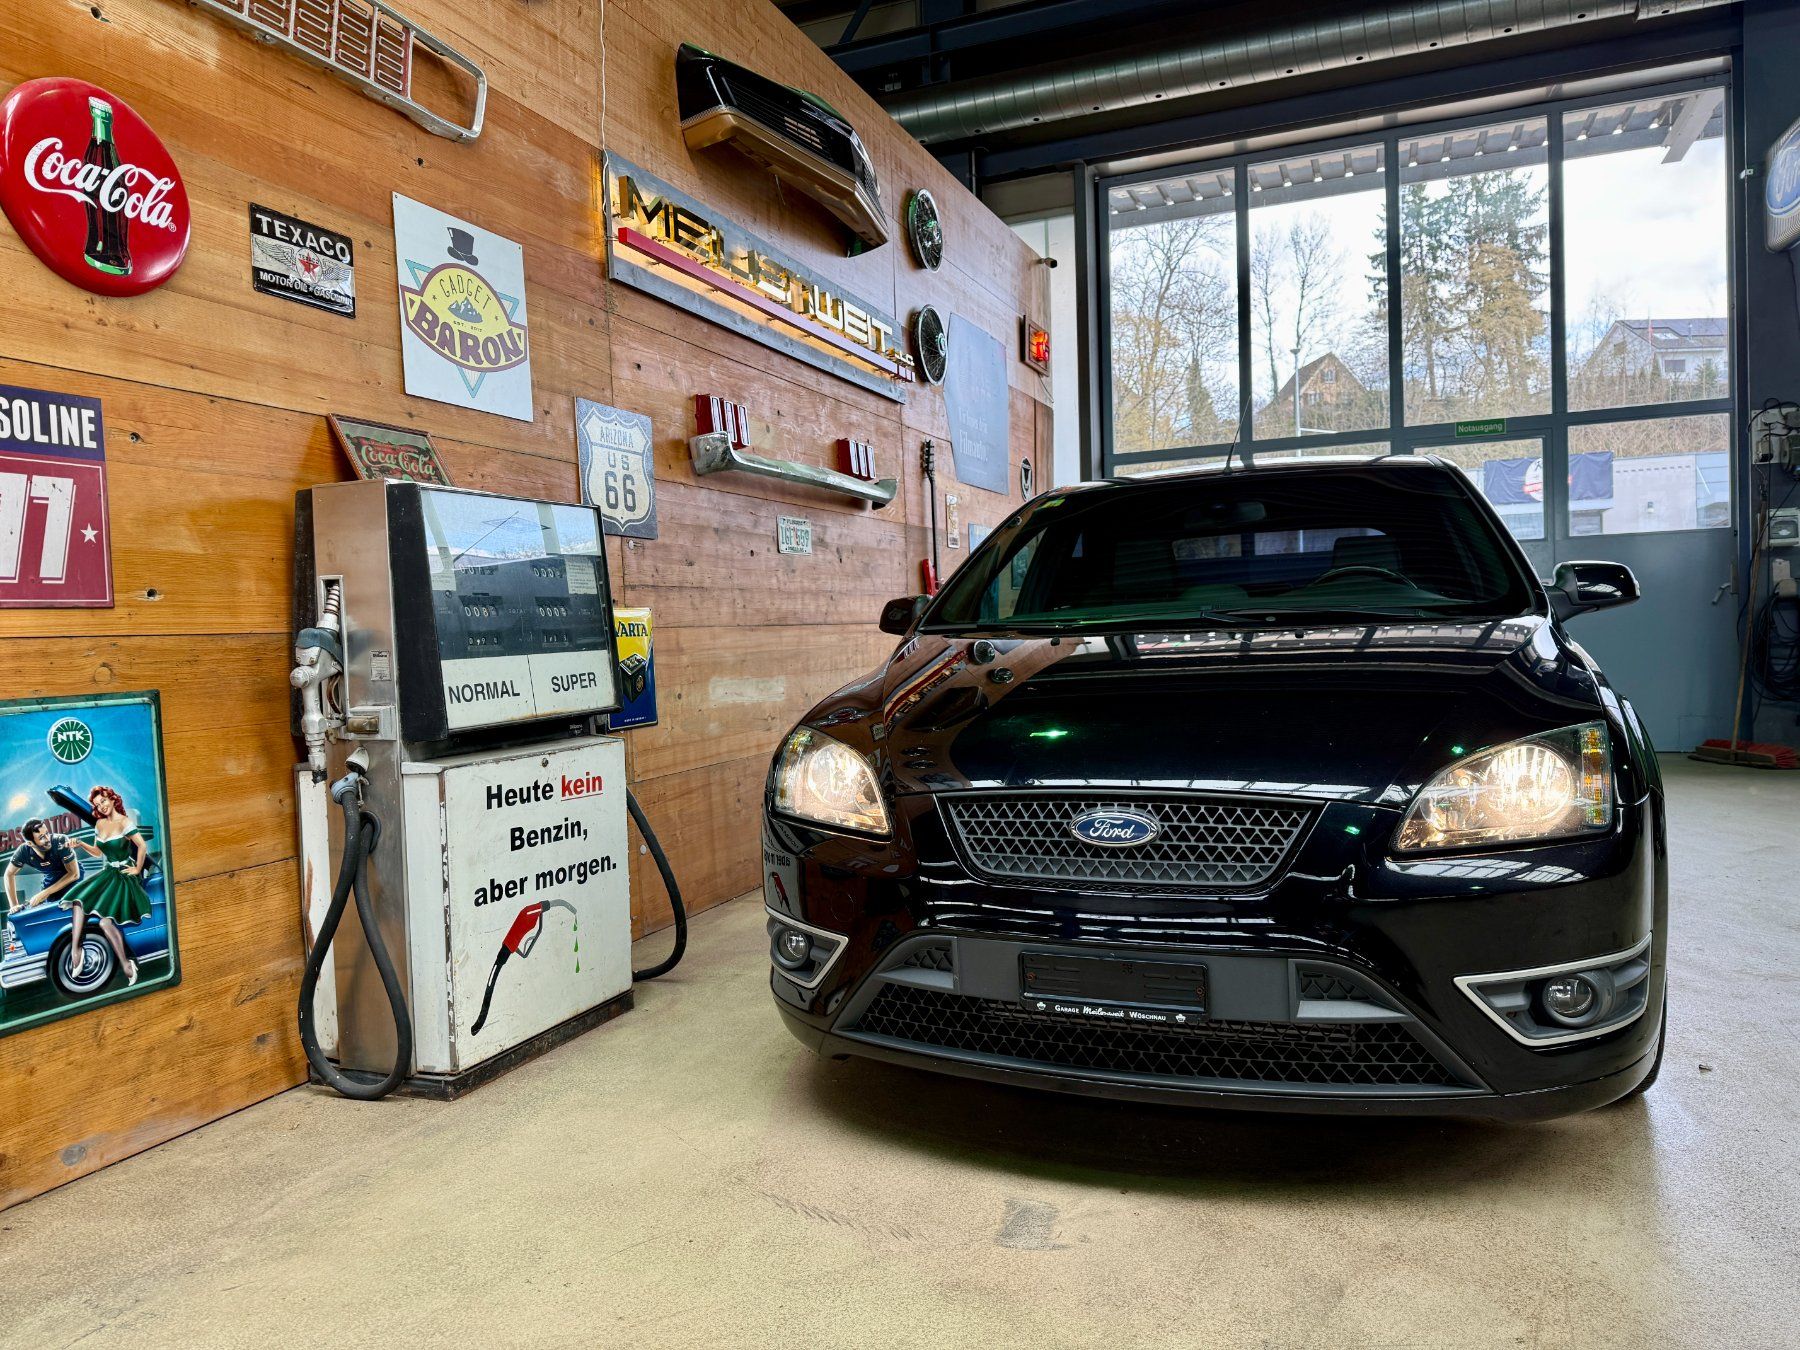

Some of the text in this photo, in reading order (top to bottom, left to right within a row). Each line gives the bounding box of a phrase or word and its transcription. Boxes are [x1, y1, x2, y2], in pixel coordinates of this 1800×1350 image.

[23, 137, 176, 229] Coca-Cola
[255, 214, 351, 263] TEXACO
[259, 271, 294, 287] MOTOR
[294, 279, 308, 292] OIL
[439, 274, 492, 310] GADGET
[411, 301, 523, 366] BARON
[599, 426, 634, 448] ARIZONA
[1458, 422, 1503, 433] Notausgang
[604, 470, 637, 513] 66
[448, 672, 598, 704] NORMAL SUPER
[57, 730, 84, 743] NTK
[485, 772, 604, 810] Heute kein
[510, 817, 588, 852] Benzin,
[1090, 818, 1136, 838] Ford
[474, 852, 618, 908] aber morgen.
